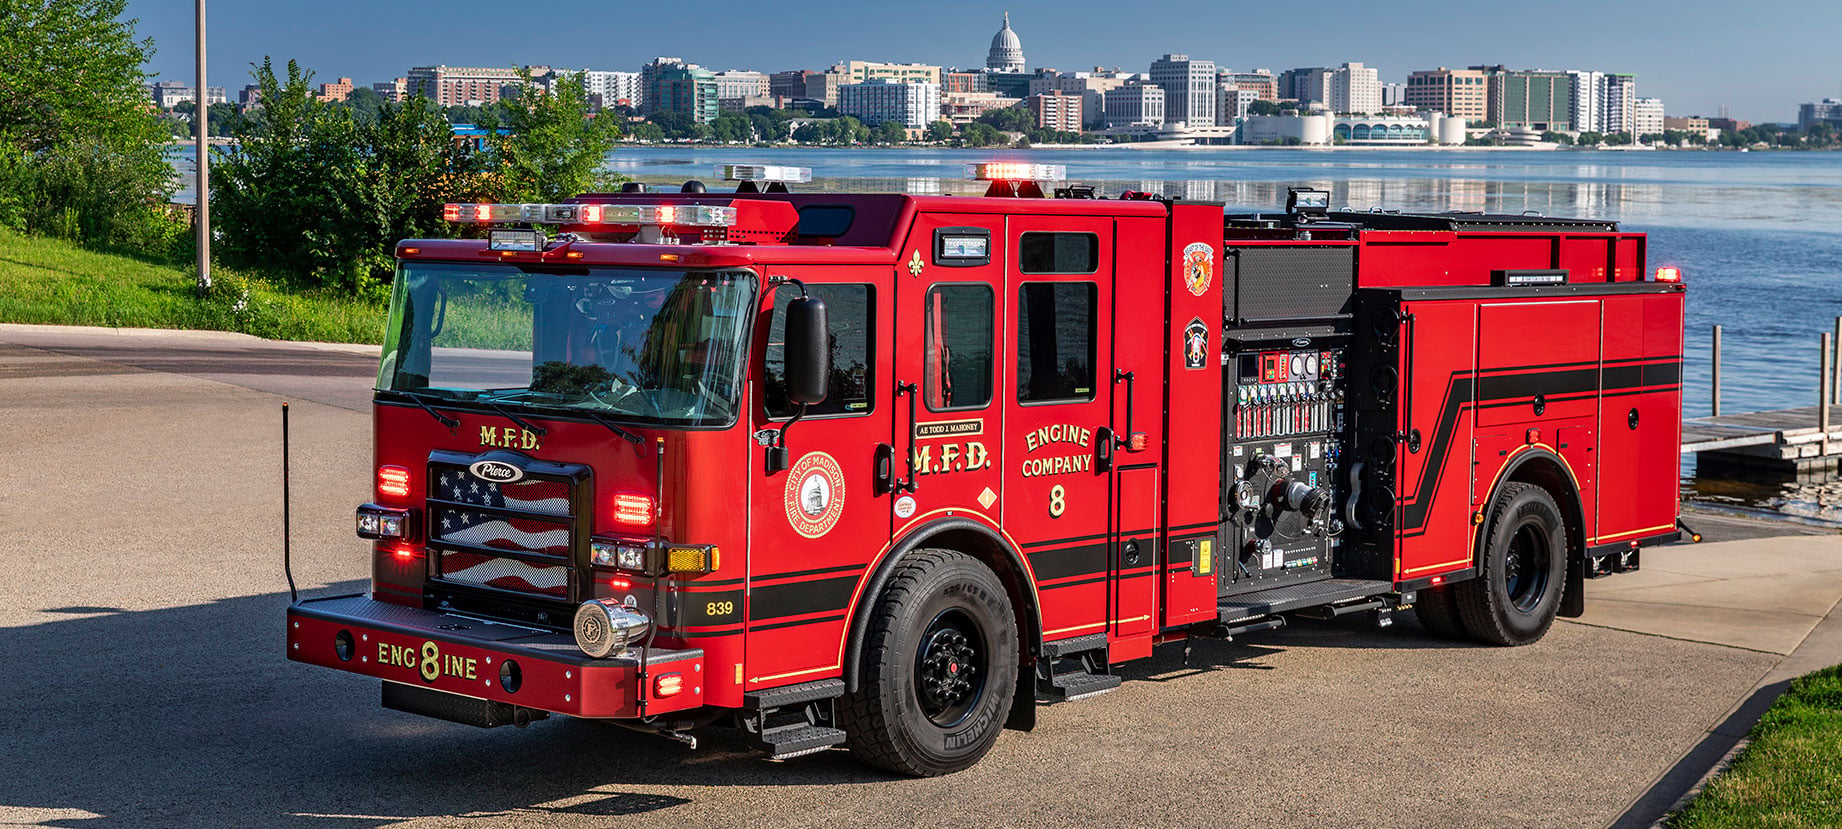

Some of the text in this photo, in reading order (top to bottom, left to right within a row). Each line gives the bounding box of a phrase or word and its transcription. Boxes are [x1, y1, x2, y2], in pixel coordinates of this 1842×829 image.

[480, 425, 540, 450] M.F.D.
[950, 423, 978, 432] MAHONEY
[1025, 424, 1091, 453] ENGINE
[481, 463, 512, 478] Pierce
[914, 442, 991, 475] M.F.D.
[1022, 454, 1092, 478] COMPANY
[789, 456, 842, 491] CITY OF MADISON
[788, 497, 841, 533] FIRE DEPARTMENT
[1049, 484, 1065, 518] 8
[706, 601, 733, 616] 839
[945, 692, 1000, 748] MICHELIN
